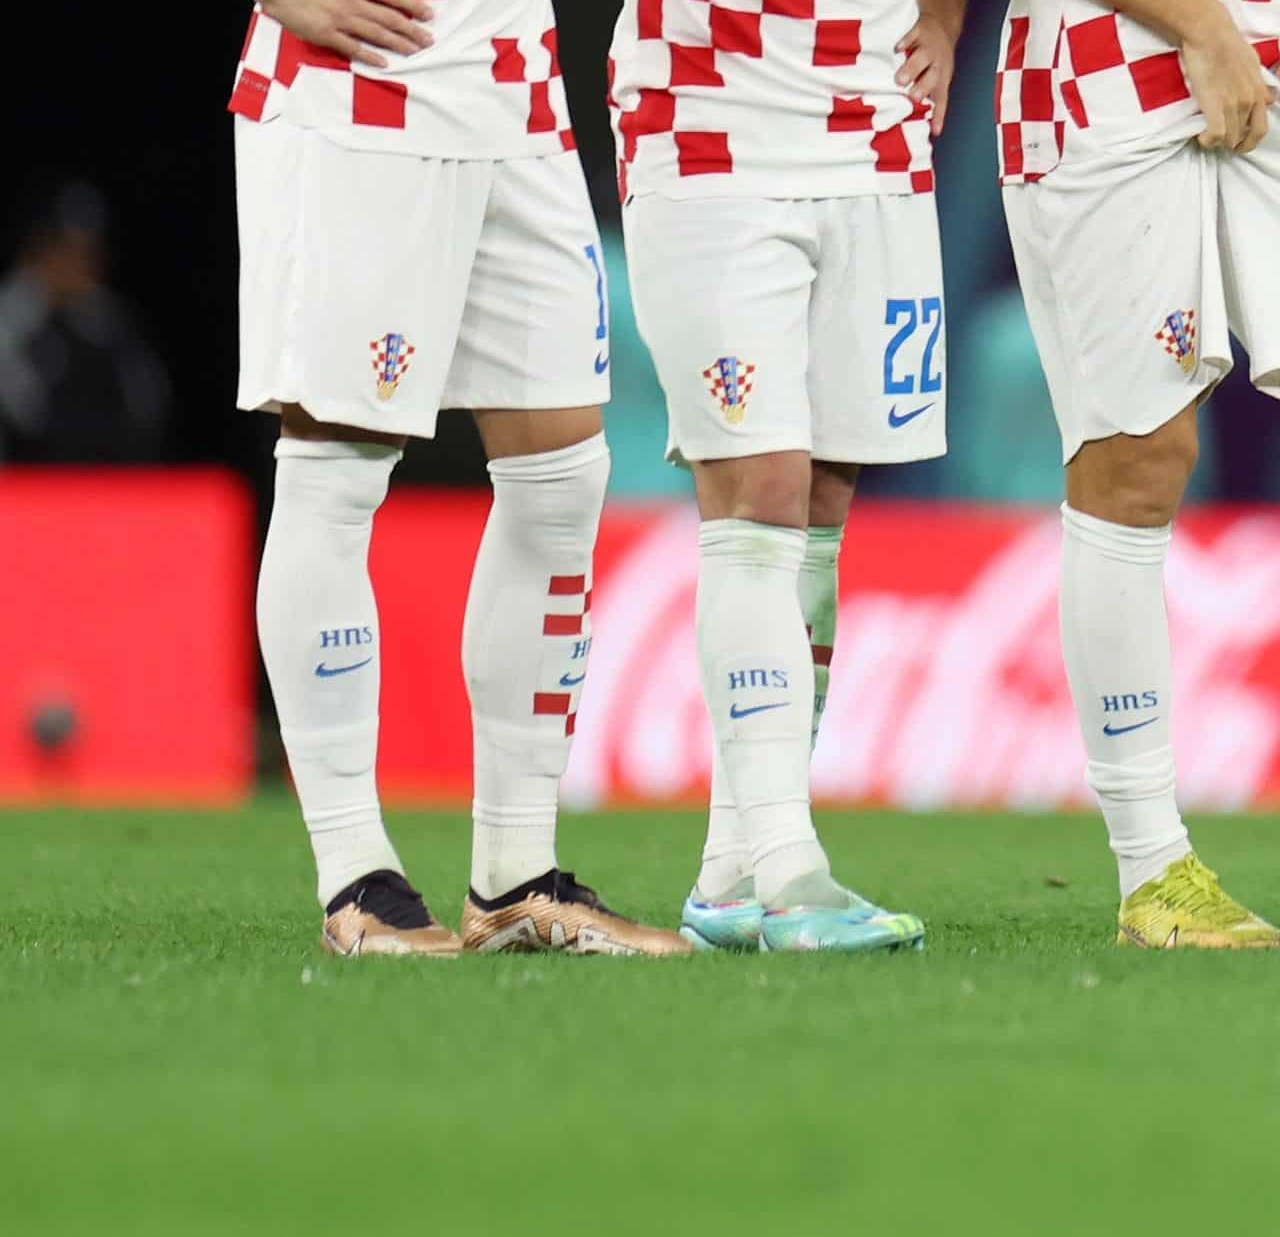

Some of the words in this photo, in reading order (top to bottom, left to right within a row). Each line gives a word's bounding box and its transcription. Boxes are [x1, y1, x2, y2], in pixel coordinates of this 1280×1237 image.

[884, 296, 942, 395] 22
[319, 626, 374, 649] HNS
[727, 668, 789, 690] HNS
[1102, 690, 1159, 713] HNS
